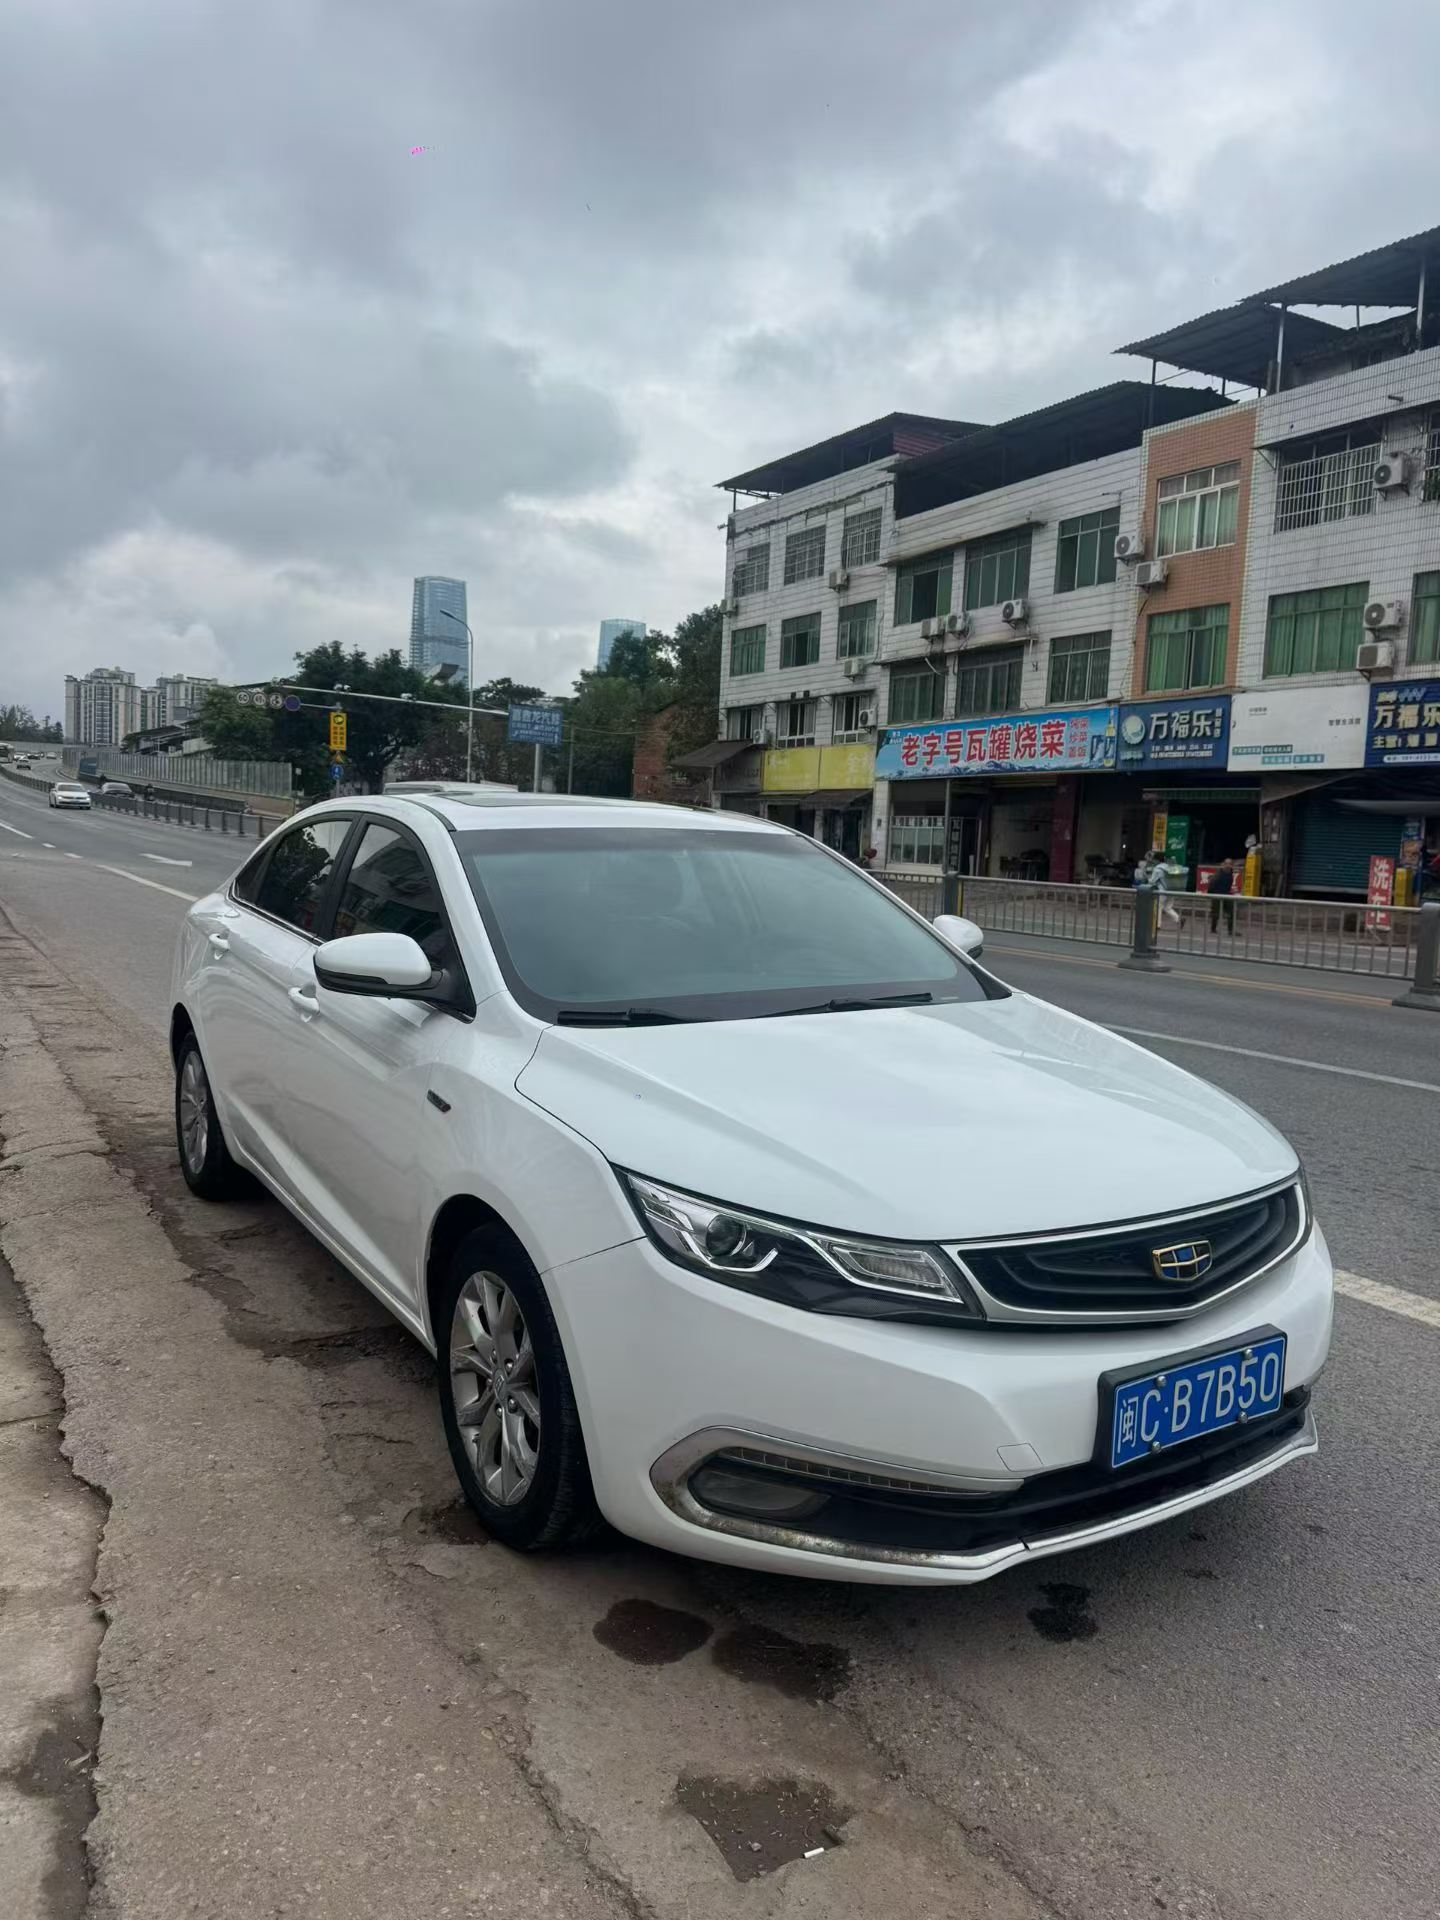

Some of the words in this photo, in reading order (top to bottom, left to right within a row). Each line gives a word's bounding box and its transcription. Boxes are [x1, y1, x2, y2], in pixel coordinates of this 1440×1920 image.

[902, 719, 1067, 767] 老字号瓦罐烧菜
[1149, 709, 1212, 740] 万福乐
[1117, 1352, 1279, 1454] 闽C·B7B50
